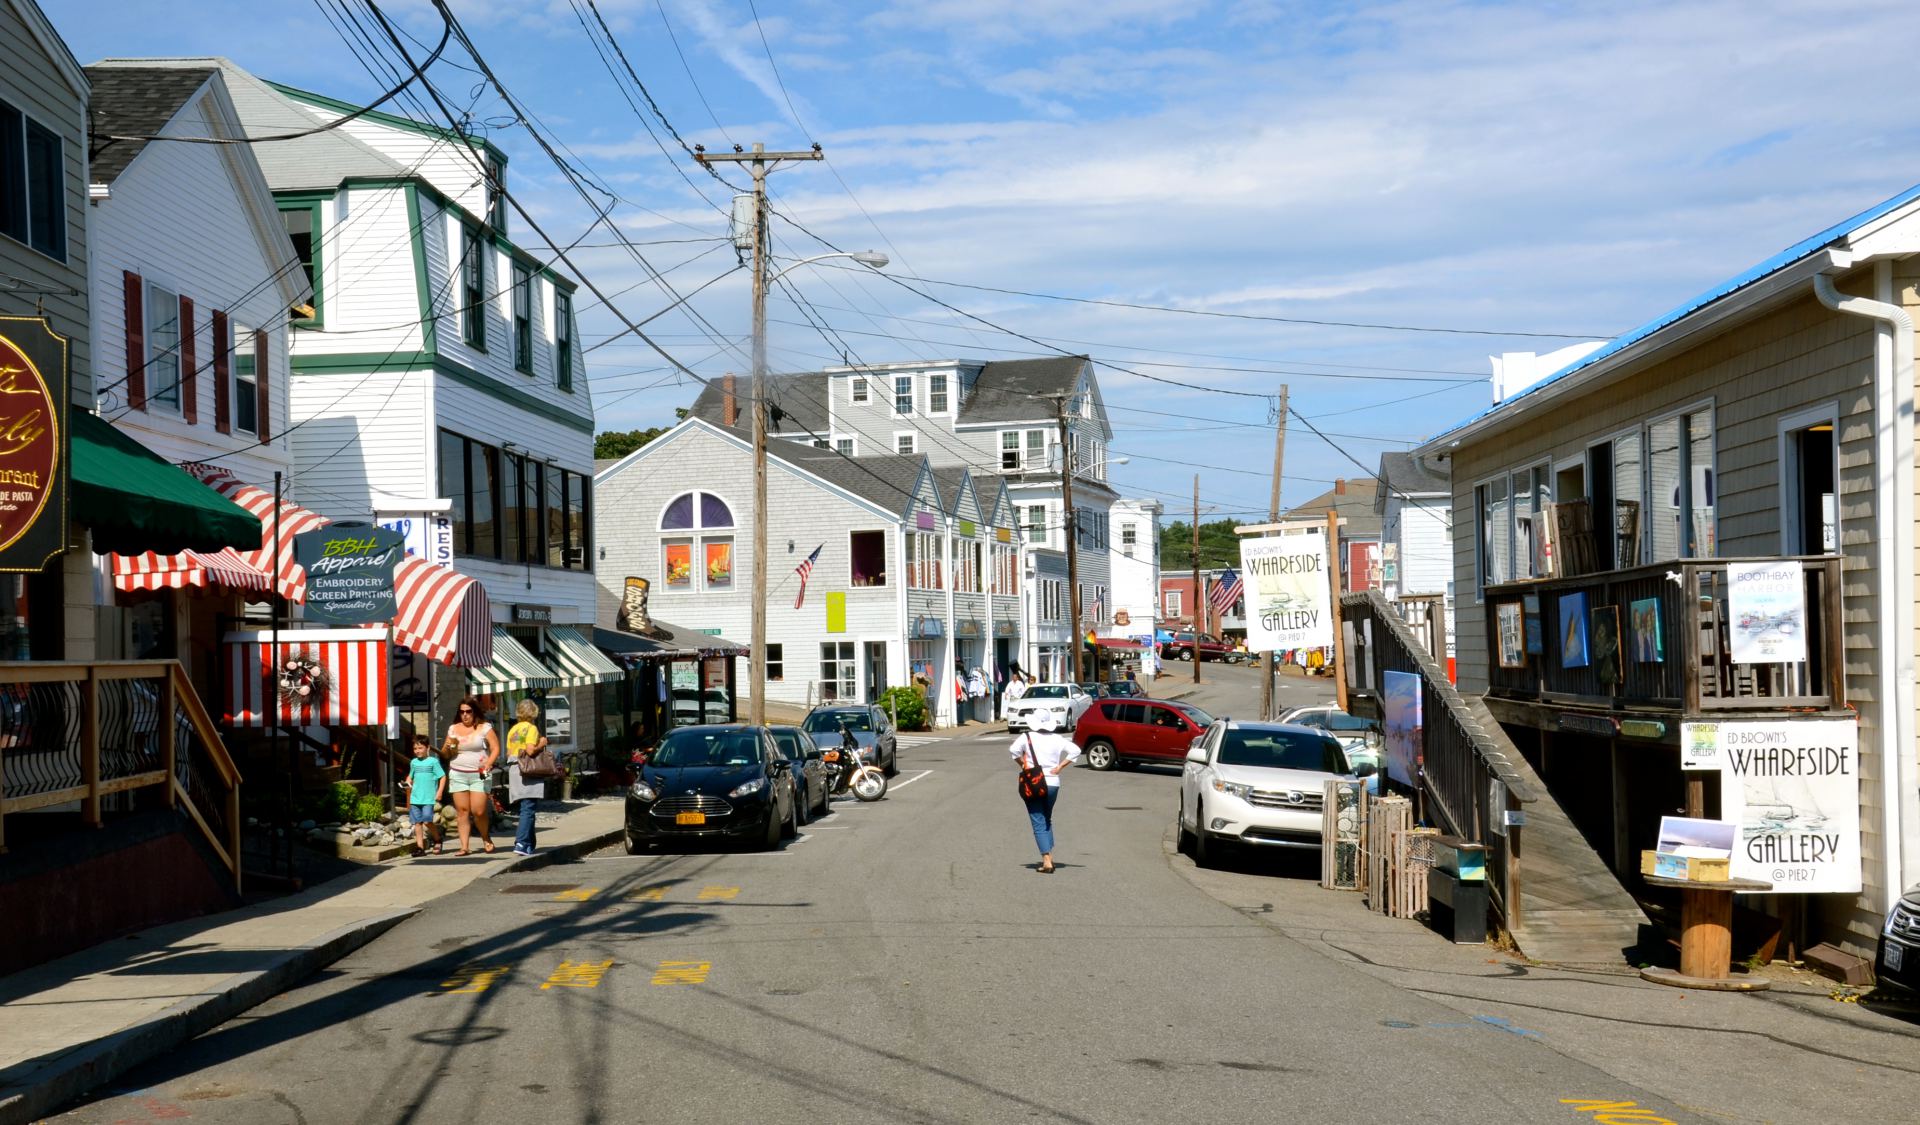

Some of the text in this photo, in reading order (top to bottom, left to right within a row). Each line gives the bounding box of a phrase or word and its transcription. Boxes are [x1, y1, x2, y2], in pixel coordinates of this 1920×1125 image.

[12, 491, 33, 502] PASTA
[322, 537, 378, 557] BBH
[310, 547, 394, 574] Apparel
[1246, 553, 1322, 576] WHARFSIDE
[316, 578, 384, 588] EMBROIDERY
[1737, 571, 1795, 582] BOOTHBAY
[309, 590, 393, 601] SCREEN PRINTING
[1262, 609, 1319, 632] GALLERY
[1288, 633, 1301, 641] PIER
[1686, 723, 1720, 733] WHARFSIDE
[1727, 731, 1787, 744] ED BROWN'S
[1691, 747, 1717, 757] GALLERY
[1727, 747, 1849, 777] WHARFSIDE
[1747, 834, 1840, 864] GALLERY
[1788, 869, 1808, 881] PIER
[1810, 868, 1816, 881] 7
